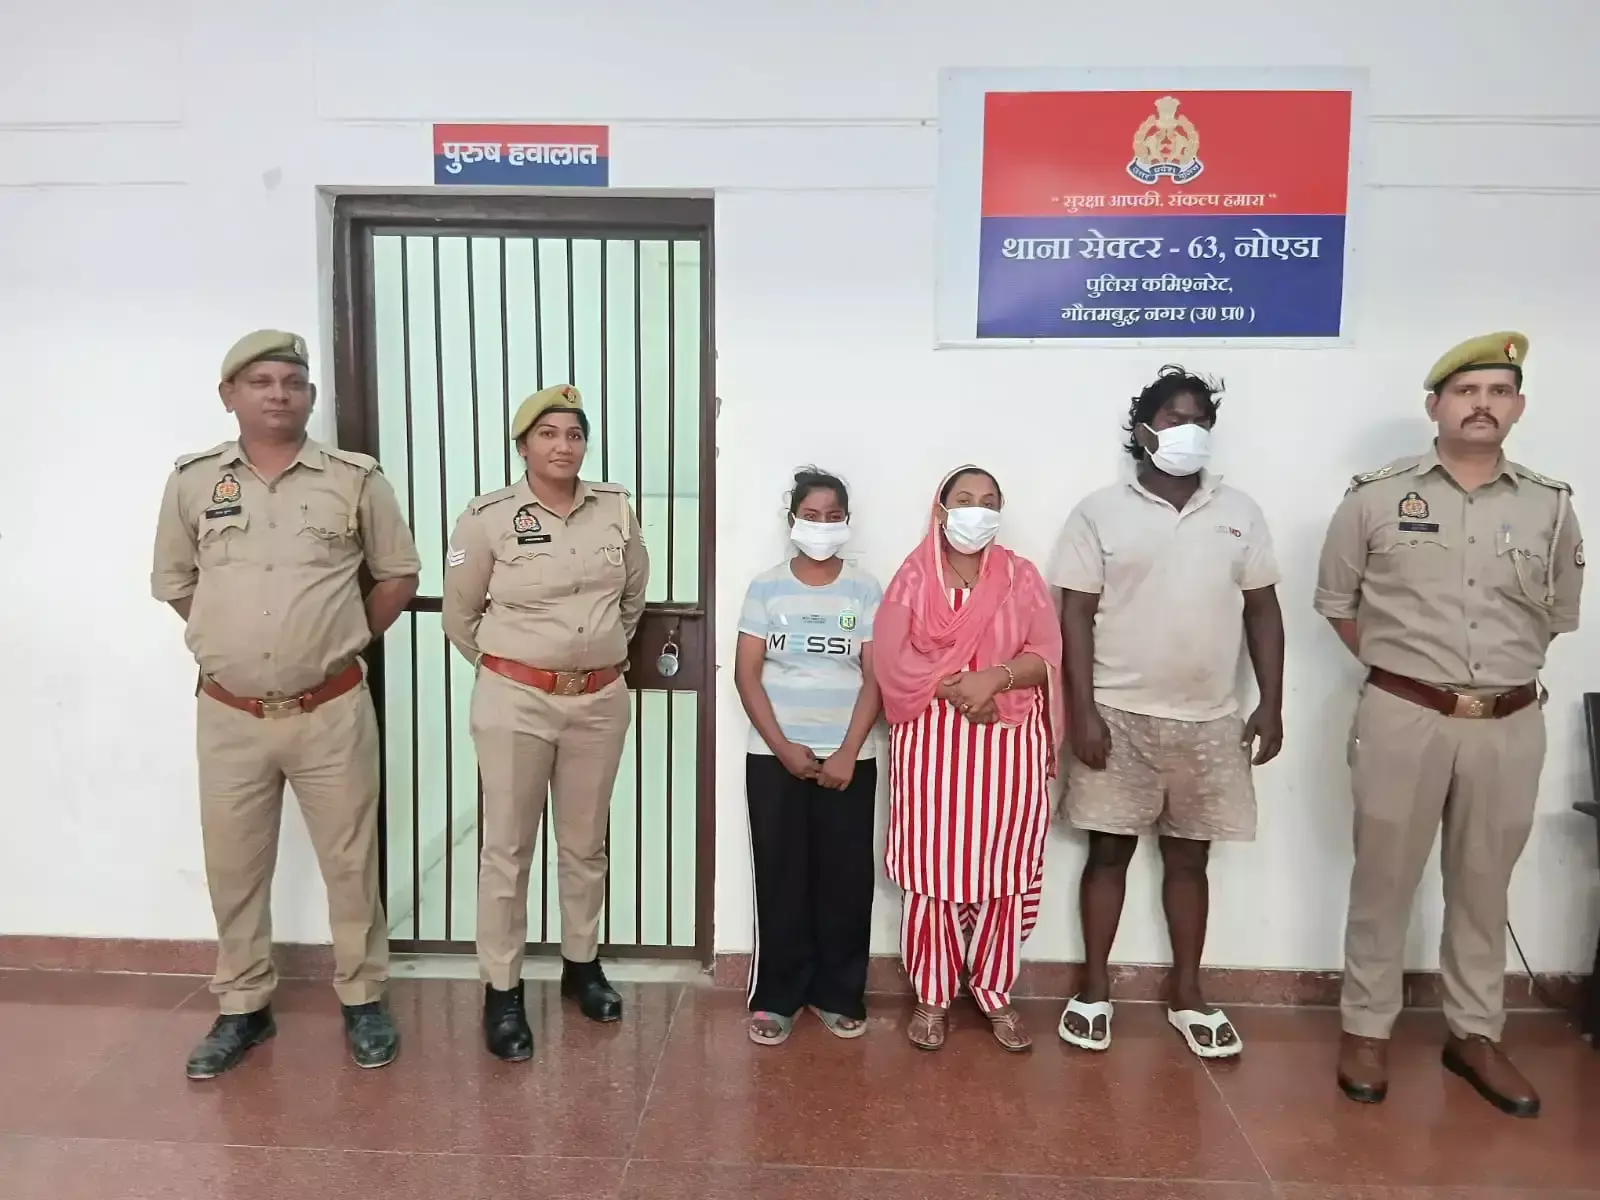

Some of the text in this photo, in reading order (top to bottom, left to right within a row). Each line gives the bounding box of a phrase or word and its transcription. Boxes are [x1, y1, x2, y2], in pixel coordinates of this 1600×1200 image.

[442, 142, 599, 174] पुरुष हवालात
[1168, 190, 1220, 207] संकल्प
[1001, 238, 1074, 260] थाना
[1078, 228, 1165, 259] सेक्टर
[1188, 235, 1226, 264] 63,
[1234, 228, 1323, 261] नोएडा
[1085, 274, 1138, 298] पुलिस
[1061, 303, 1140, 328] गौतमबुद्ध
[1144, 306, 1187, 321] नगर
